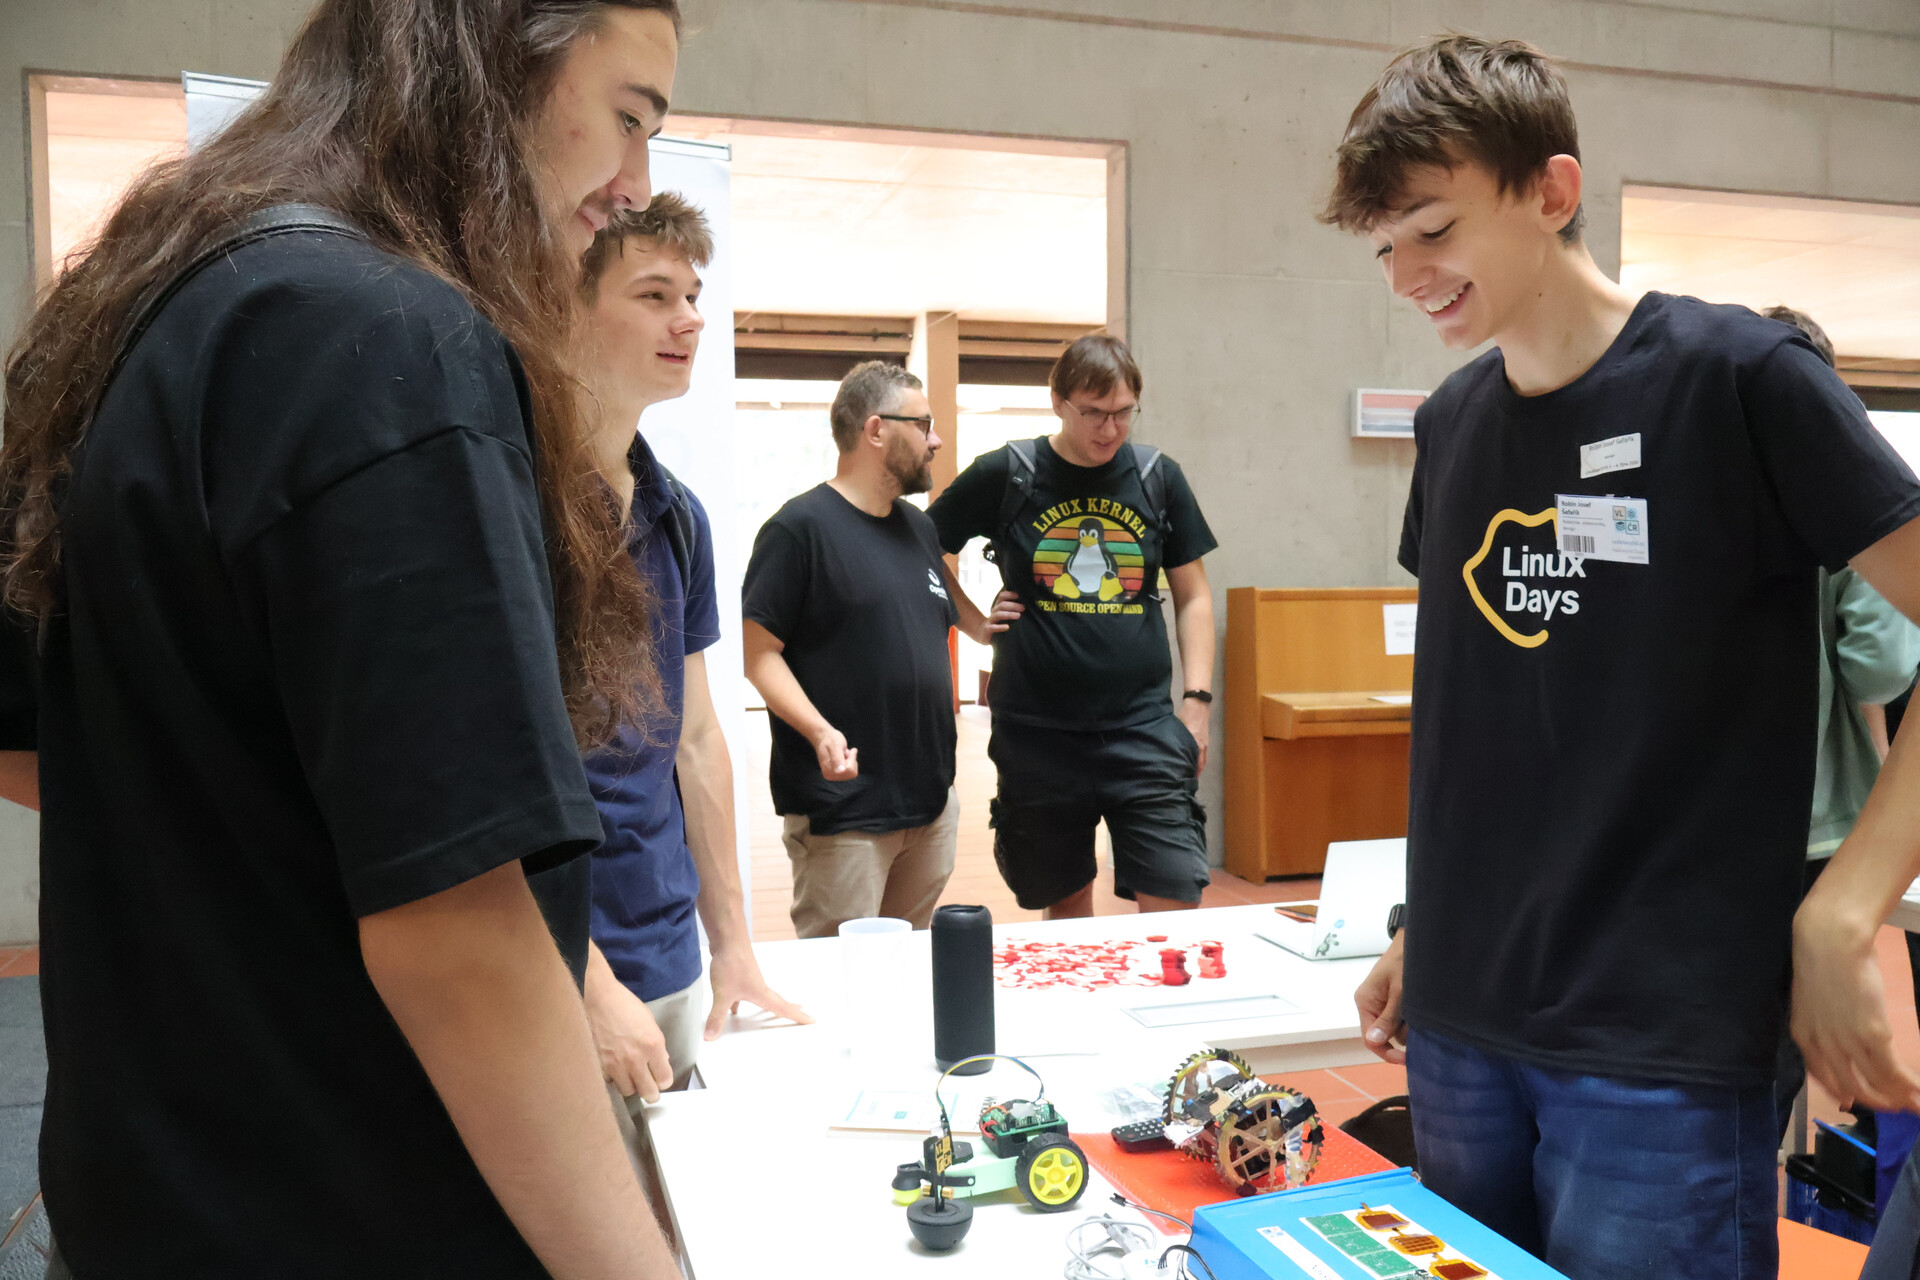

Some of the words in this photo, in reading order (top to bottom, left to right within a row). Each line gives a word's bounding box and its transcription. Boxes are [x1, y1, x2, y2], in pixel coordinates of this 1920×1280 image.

[1032, 498, 1082, 533] LINUX
[1087, 498, 1147, 539] KERNEL
[1627, 523, 1638, 532] ČR
[1502, 545, 1587, 578] Linux
[1035, 600, 1057, 613] PEN
[1058, 602, 1096, 613] SOURCE
[1097, 603, 1121, 614] OPEN
[1505, 581, 1580, 621] Days
